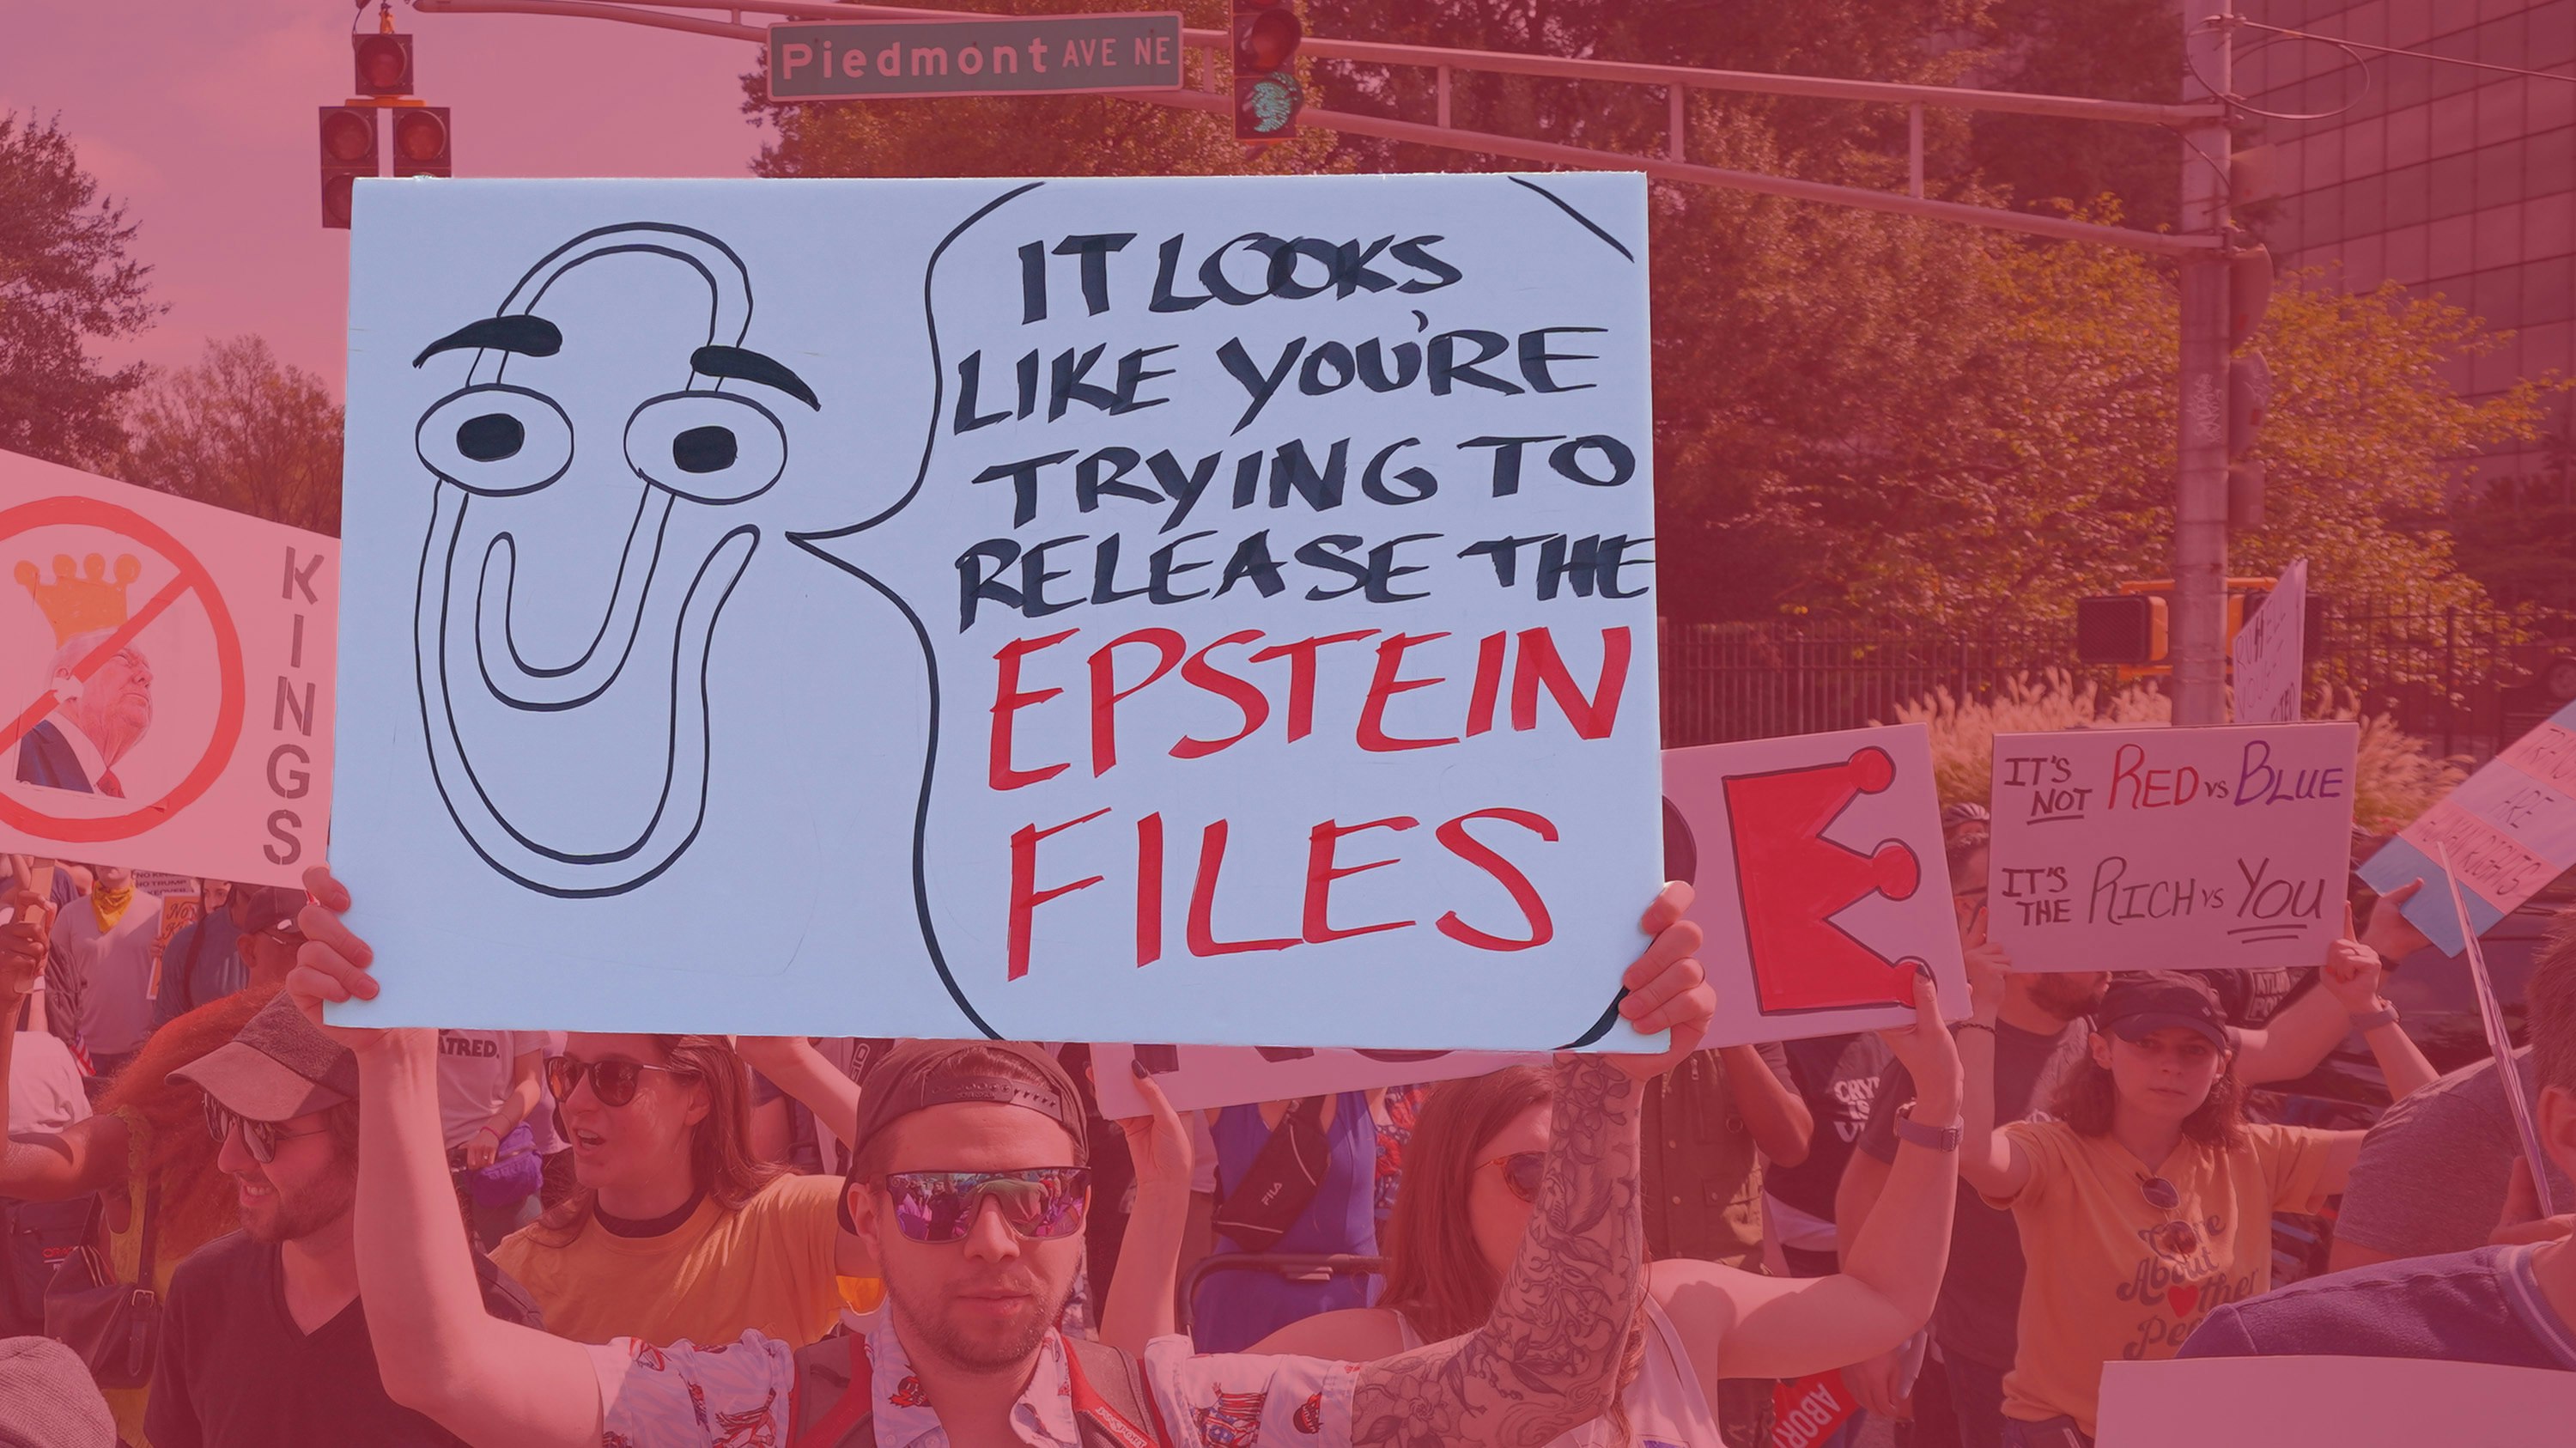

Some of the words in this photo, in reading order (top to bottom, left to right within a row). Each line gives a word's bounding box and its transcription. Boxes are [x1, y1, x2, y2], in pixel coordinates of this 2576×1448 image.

[782, 37, 1048, 80] Piedmont
[1062, 38, 1116, 67] AVE
[1133, 37, 1171, 65] NE
[1018, 233, 1137, 325] IT
[1149, 232, 1463, 313] LOOKS
[955, 343, 1179, 436] LIKE
[1216, 310, 1608, 437] YOU'RE
[972, 437, 1438, 534] TRYING
[1456, 435, 1636, 498] TO
[955, 529, 1444, 635] RELEASE
[1456, 532, 1656, 602] THE
[263, 545, 325, 866] KINGS
[989, 626, 1632, 790] EPSTEIN
[2003, 757, 2072, 787] IT'S
[2030, 788, 2093, 817] NOT
[2107, 743, 2200, 810] RED
[2233, 739, 2344, 807] BLUE
[2488, 787, 2555, 829] ARE
[1007, 806, 1559, 982] FILES
[2001, 866, 2069, 897] IT'S
[2015, 898, 2072, 926] THE
[2087, 855, 2196, 926] RICH
[2236, 856, 2326, 920] YOU
[1261, 1182, 1283, 1206] FILA
[2117, 1247, 2219, 1305] About
